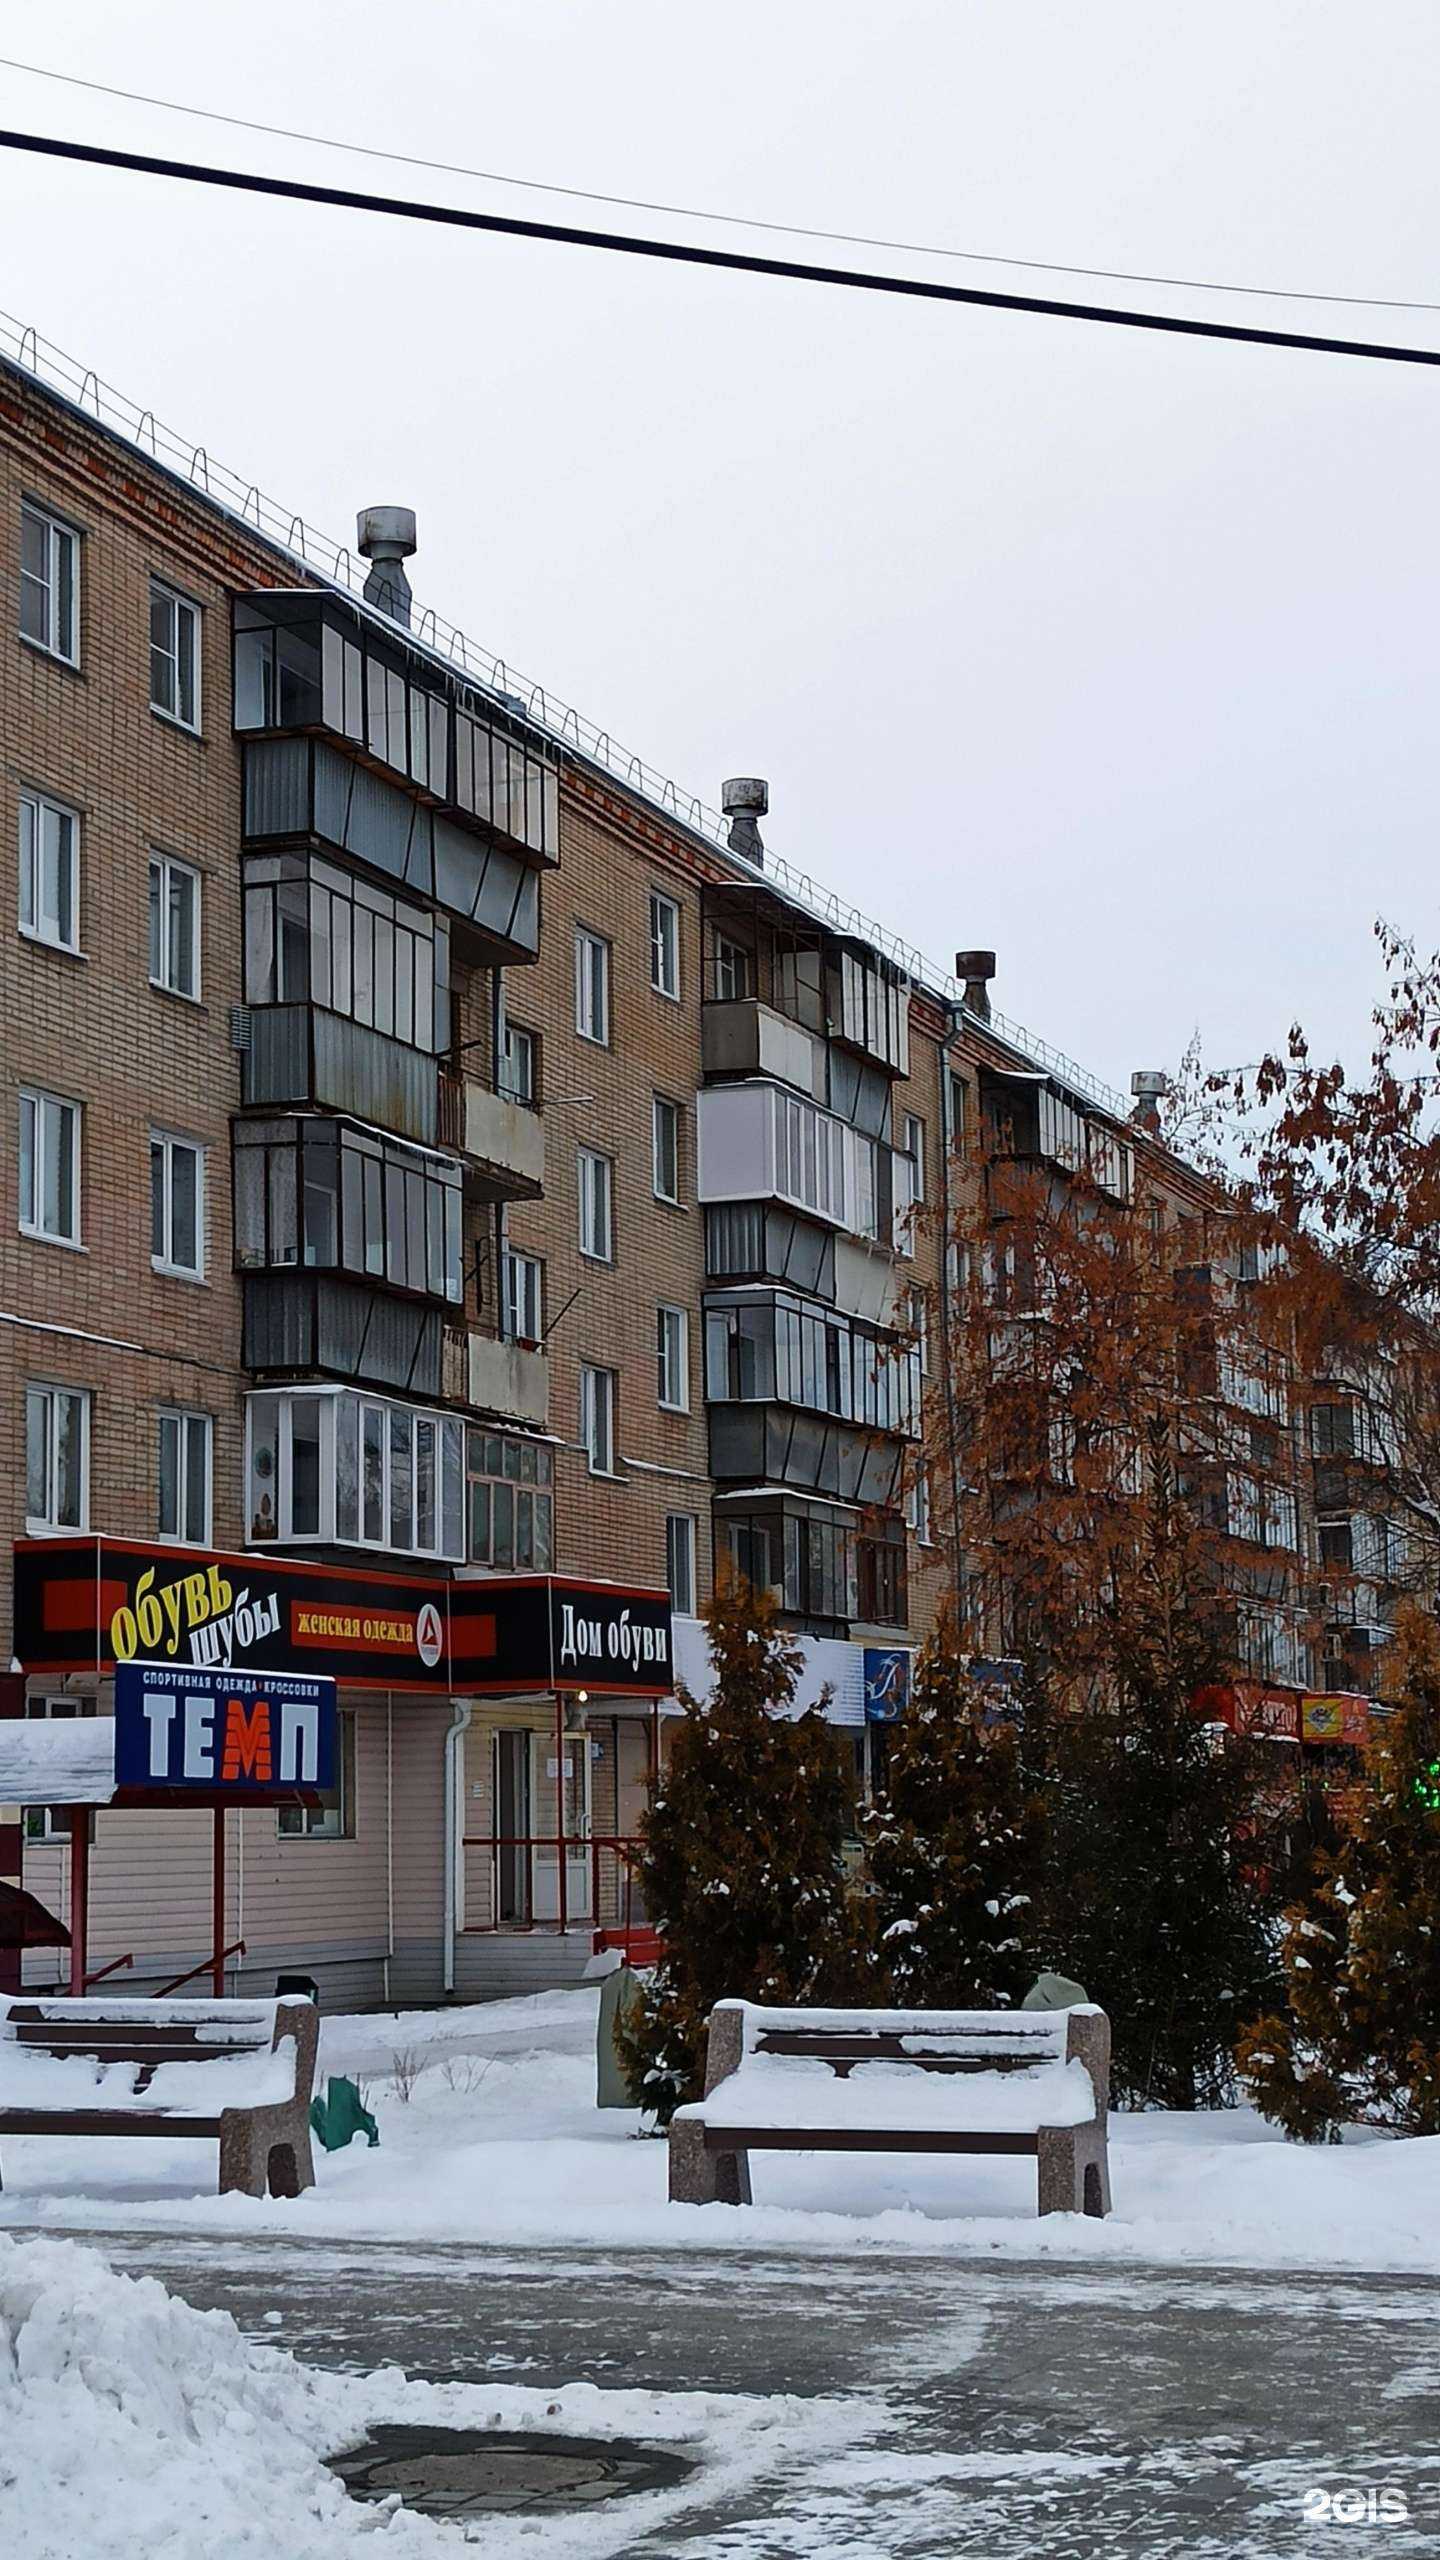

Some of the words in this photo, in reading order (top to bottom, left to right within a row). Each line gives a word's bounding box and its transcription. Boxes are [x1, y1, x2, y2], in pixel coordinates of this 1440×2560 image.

[189, 1587, 281, 1667] шубы
[561, 1604, 602, 1666] Дом
[608, 1608, 667, 1672] обуви
[143, 1671, 211, 1689] СПОРТИВНАЯ
[216, 1677, 257, 1693] ОДЕЖДА
[264, 1681, 319, 1697] КРОССОВКИ
[143, 1693, 319, 1781] ТЕМП
